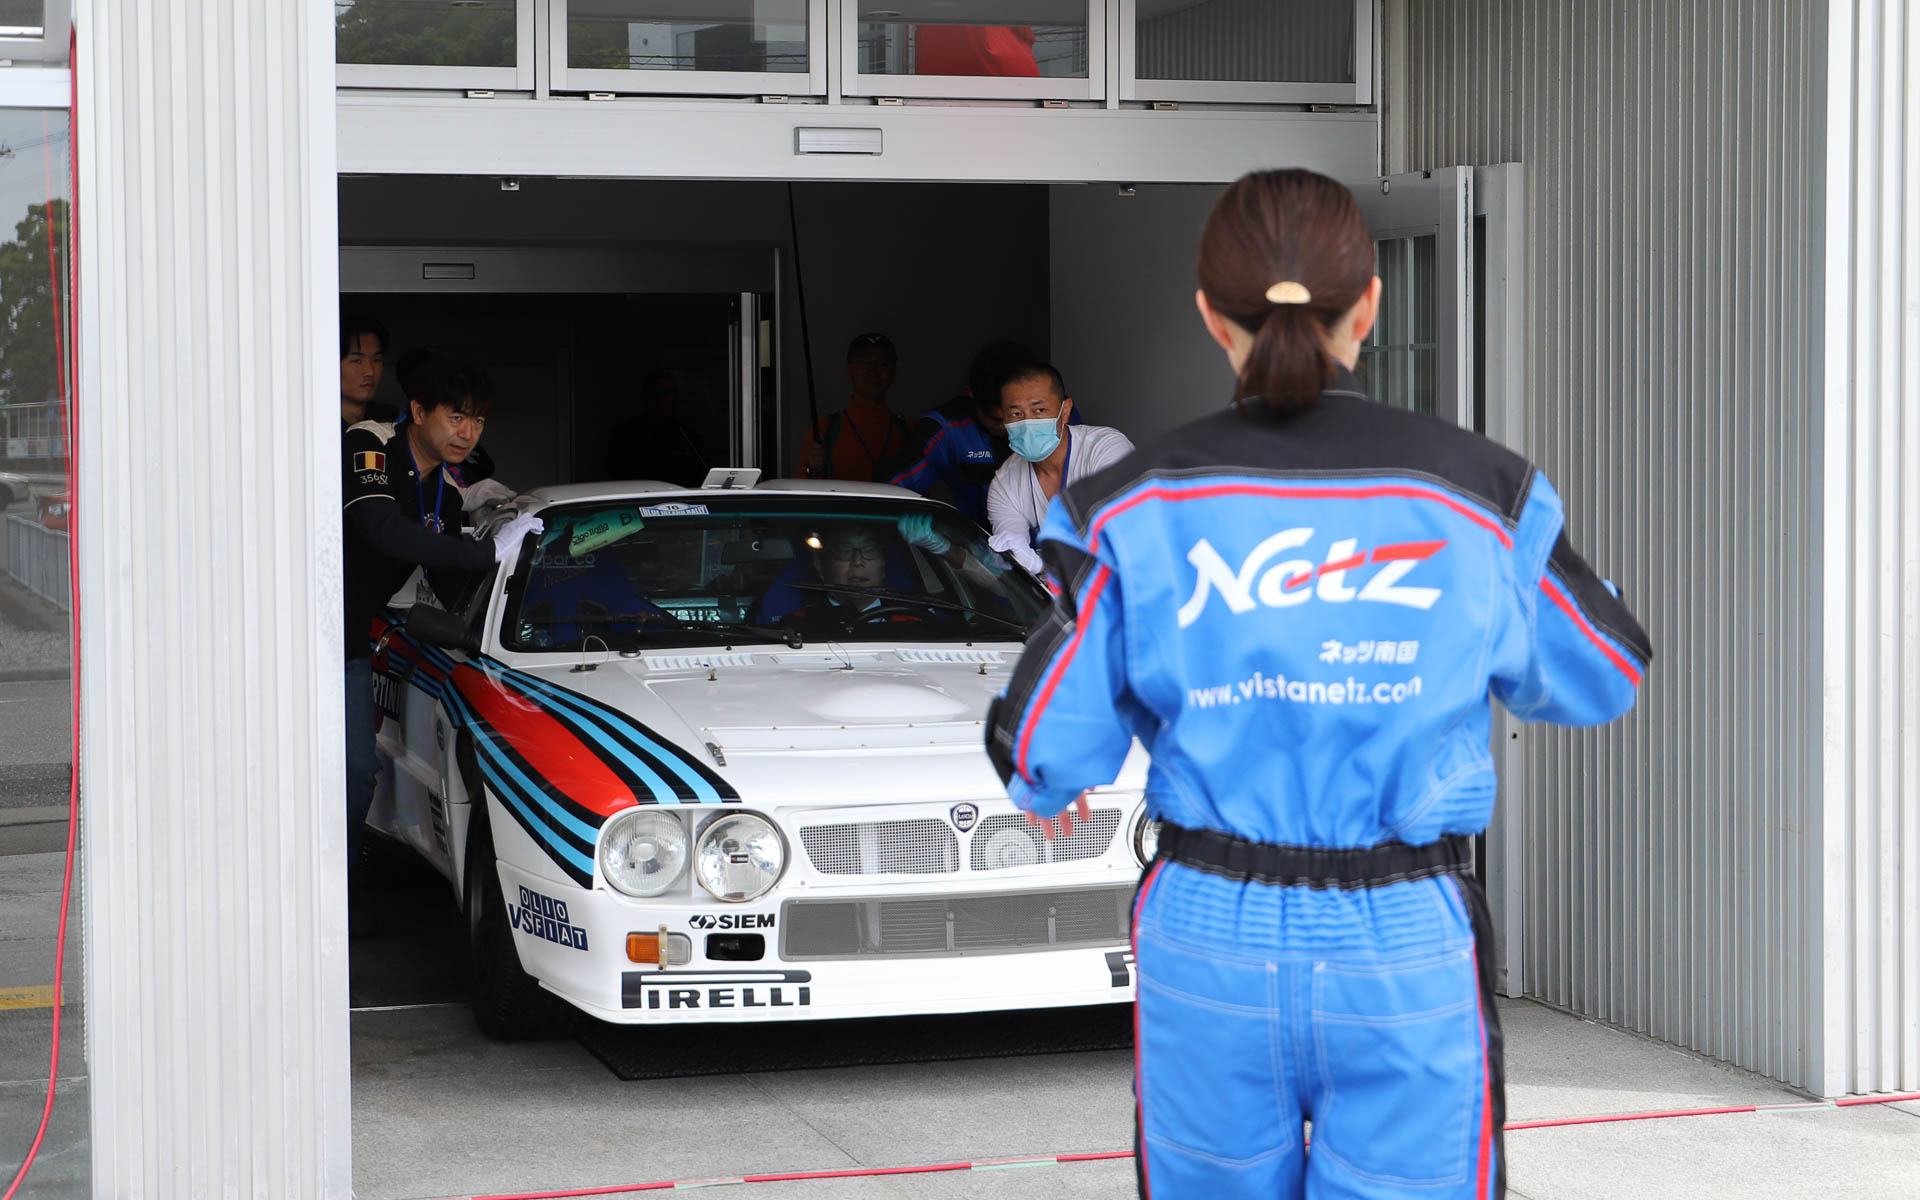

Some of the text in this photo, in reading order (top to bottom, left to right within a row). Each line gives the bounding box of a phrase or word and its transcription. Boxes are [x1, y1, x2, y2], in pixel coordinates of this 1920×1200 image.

[1178, 527, 1449, 629] Netz
[1319, 640, 1419, 664] ネッツ南国
[373, 672, 401, 715] RTINI
[519, 886, 569, 922] OLIO
[718, 913, 775, 930] SIEM
[622, 970, 812, 1009] PIRELLI
